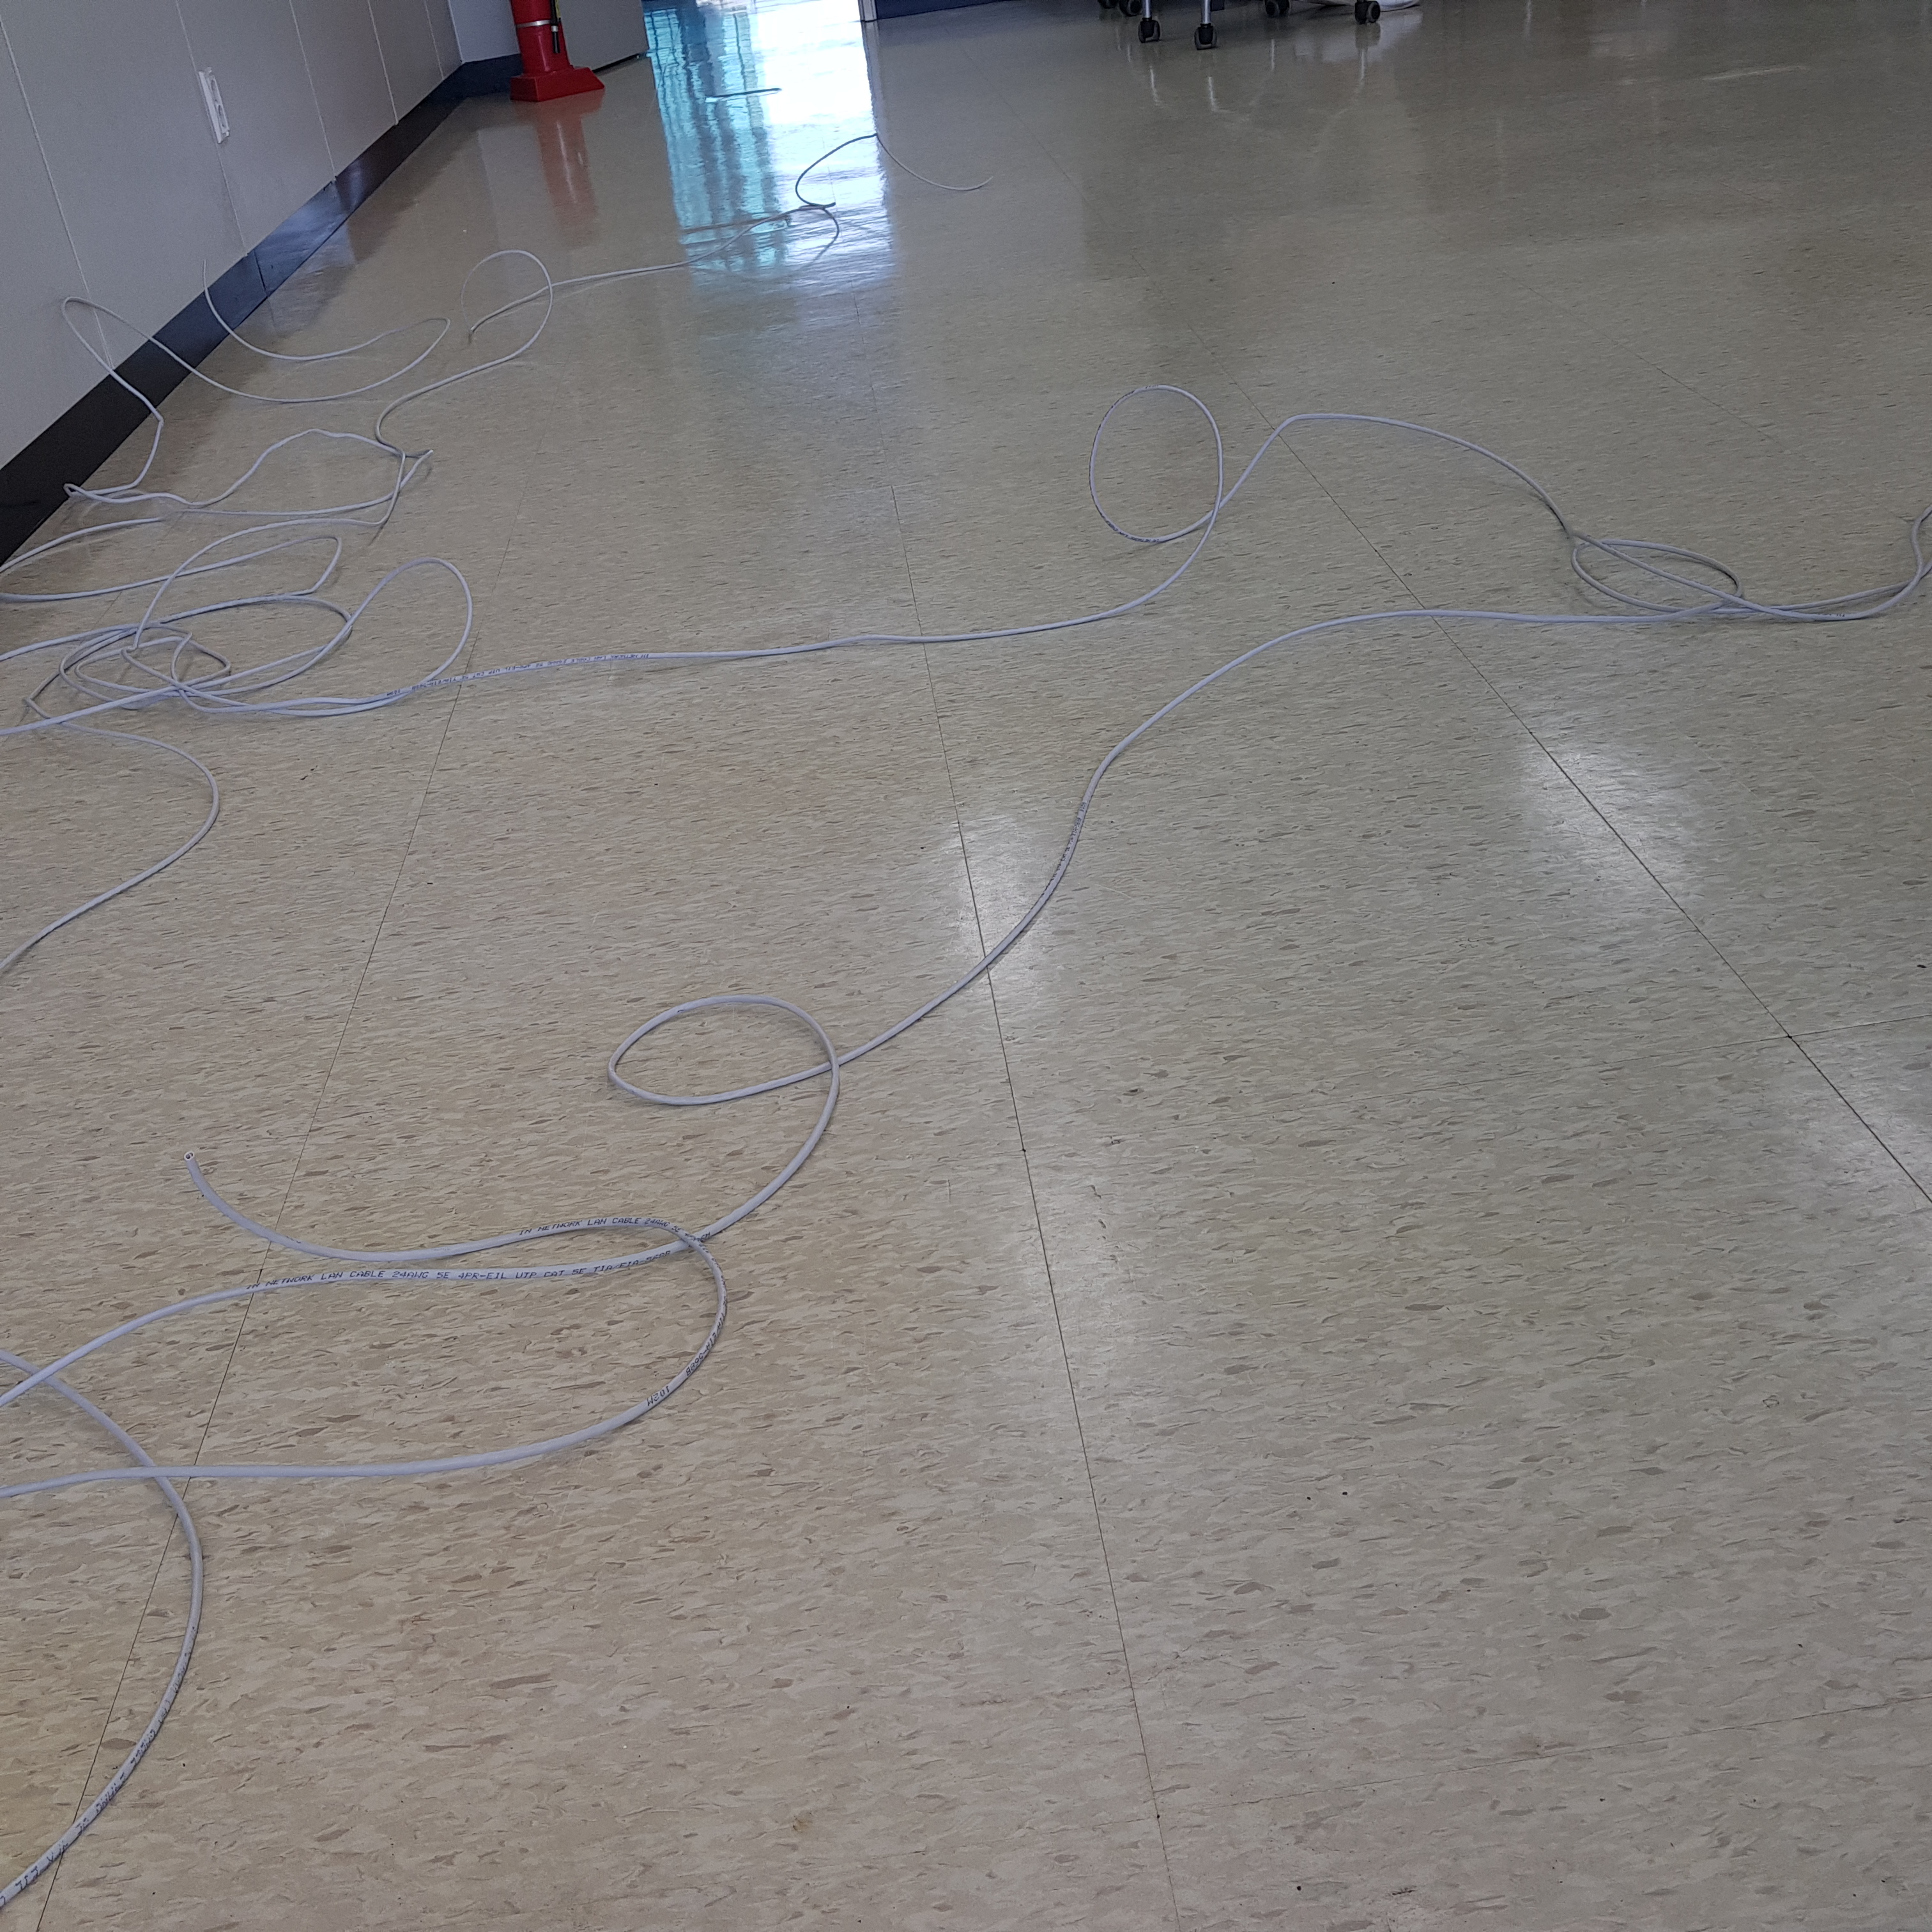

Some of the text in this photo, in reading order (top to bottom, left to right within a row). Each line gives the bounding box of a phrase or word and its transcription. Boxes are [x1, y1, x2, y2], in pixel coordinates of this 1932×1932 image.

[537, 1220, 583, 1232] NETWORK
[265, 1275, 316, 1287] NETWORK
[321, 1271, 344, 1280] LAN
[349, 1269, 386, 1278] CABLE
[392, 1270, 429, 1279] 24AWG
